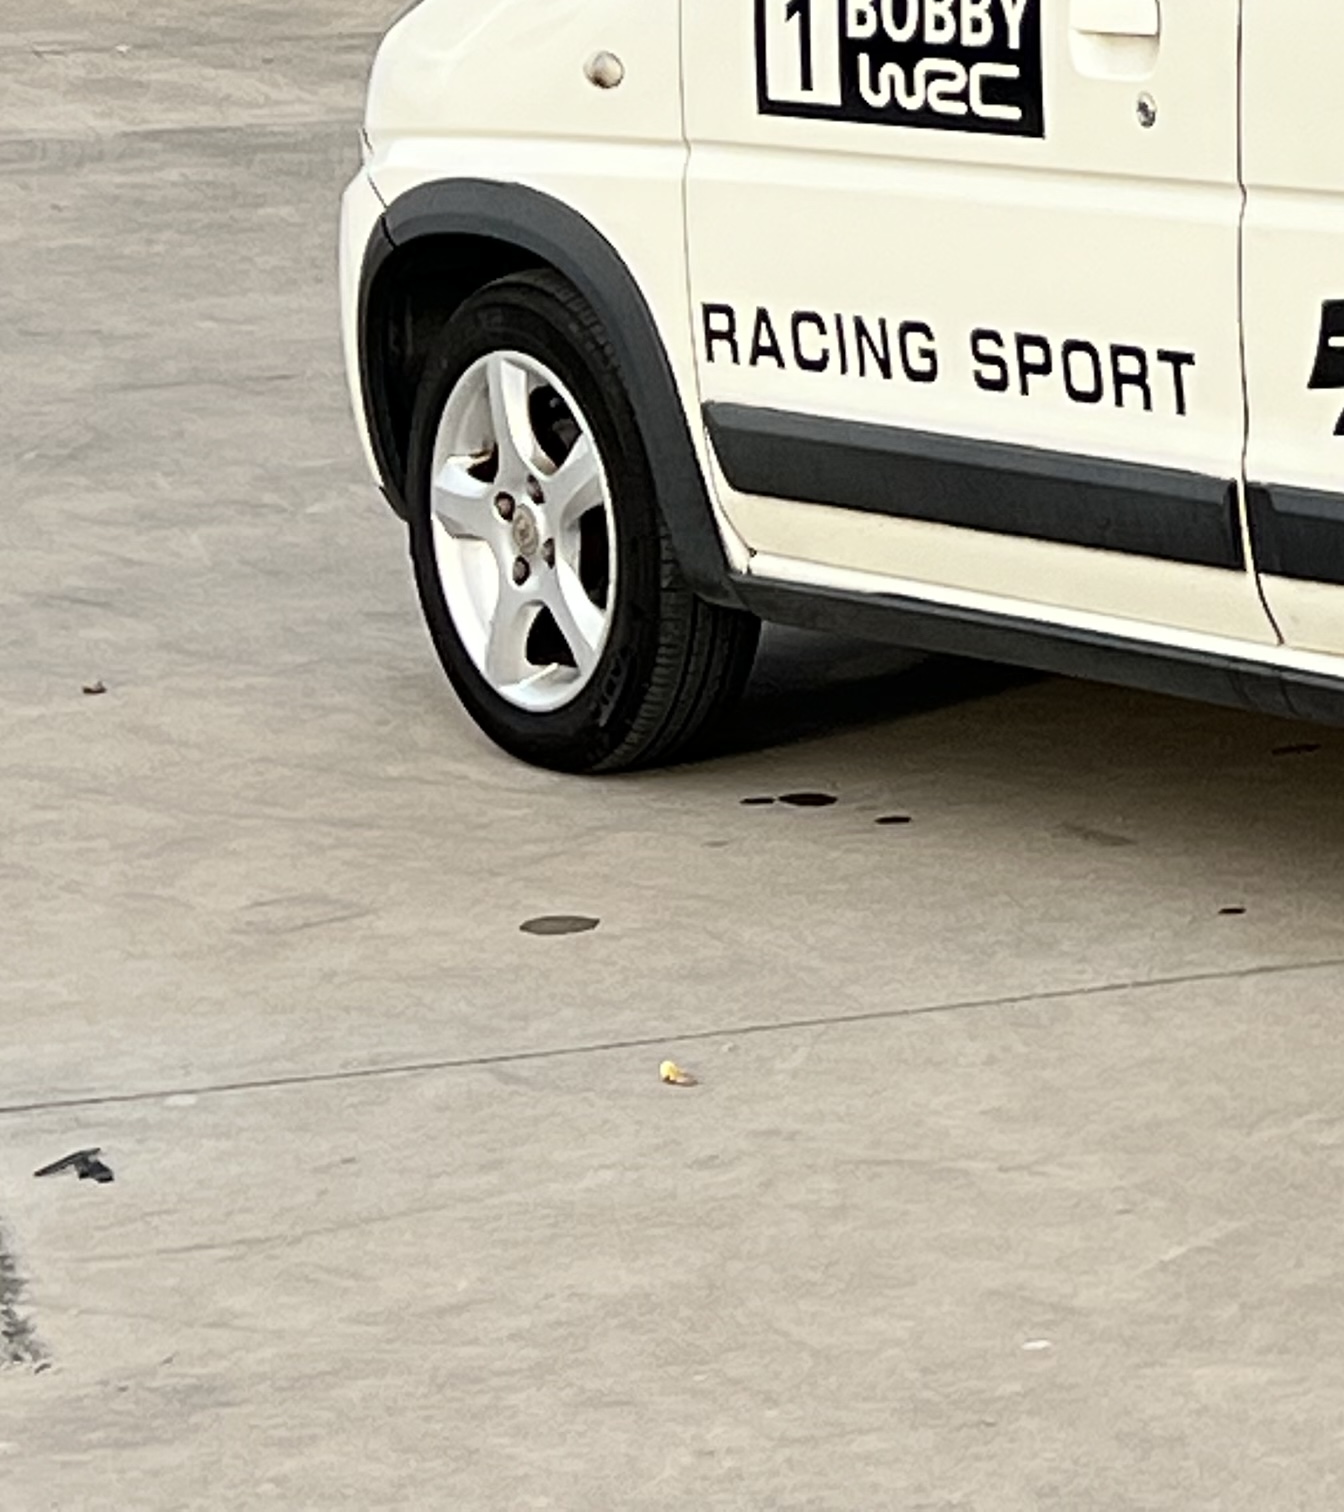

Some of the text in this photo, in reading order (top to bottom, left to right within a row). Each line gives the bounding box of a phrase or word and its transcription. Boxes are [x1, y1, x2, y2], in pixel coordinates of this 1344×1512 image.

[857, 52, 1023, 121] WRC
[701, 302, 1196, 416] RACING SPORT
